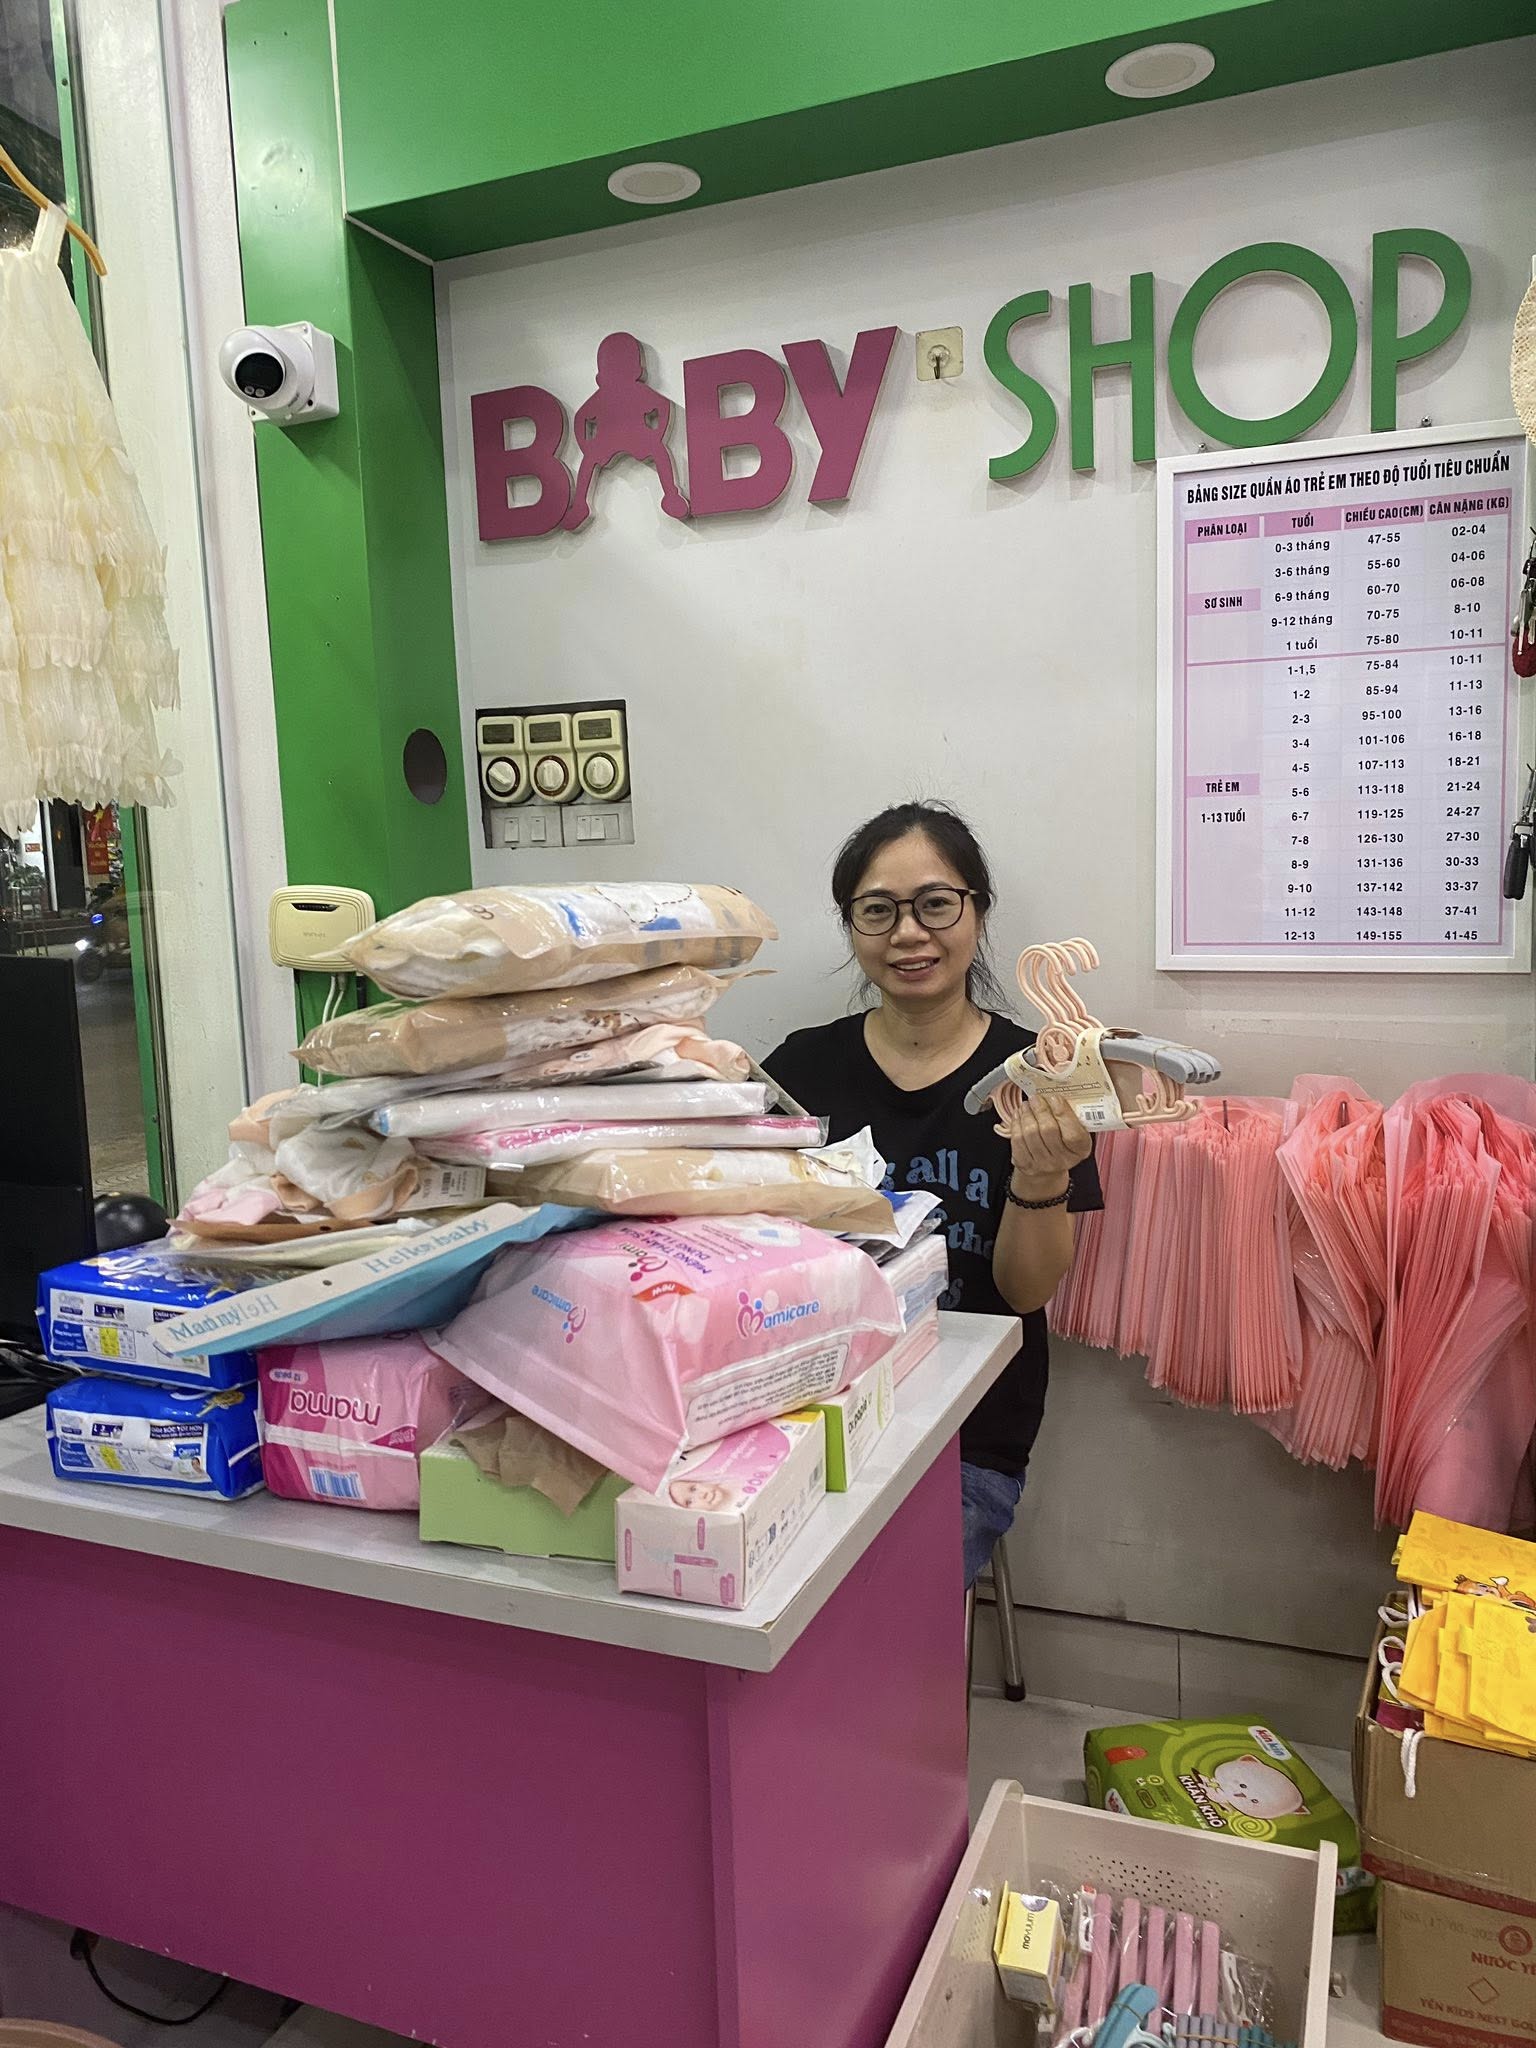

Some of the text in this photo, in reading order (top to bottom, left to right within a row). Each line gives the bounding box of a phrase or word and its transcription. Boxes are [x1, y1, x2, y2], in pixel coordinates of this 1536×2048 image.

[984, 229, 1472, 481] SHOP
[1188, 450, 1509, 503] BẢNG SIZE QUẦN ÁO TRẺ EM THEO ĐỘ TUỔI TIÊU CHUẨN
[1430, 497, 1508, 514] CÂN NẶNG (KG)
[1379, 505, 1423, 519] CAO(CM)
[1198, 523, 1246, 537] PHÂN LOẠI
[1452, 524, 1485, 536] 02-04
[1368, 533, 1400, 544] 47-55
[1276, 540, 1329, 552] 0-3 tháng
[1452, 550, 1485, 562] 04-06
[1368, 558, 1400, 569] 55-60
[1276, 565, 1329, 577] 3-6 tháng
[1451, 577, 1484, 588] 06-08
[1367, 584, 1399, 595] 60-70
[1275, 590, 1329, 602] 6-9 tháng
[1205, 596, 1242, 609] SƠ SINH
[1454, 603, 1480, 613] 8-10
[1367, 609, 1399, 620] 70-75
[1272, 616, 1332, 627] 9-12 tháng
[1451, 628, 1482, 639] 10-11
[1287, 637, 1317, 650] 1 tuổi
[1367, 634, 1399, 645] 75-80
[1451, 654, 1481, 664] 10-11
[1288, 665, 1315, 675] 1-1,5
[1367, 660, 1398, 670] 75-84
[1366, 685, 1398, 695] 85-94
[1450, 680, 1482, 690] 11-13
[1293, 690, 1310, 699] 1-2
[1362, 710, 1401, 720] 95-100
[1450, 705, 1481, 715] 13-16
[1293, 714, 1309, 724] 2-3
[1359, 734, 1404, 745] 101-106
[1449, 731, 1481, 741] 16-18
[1293, 739, 1309, 748] 3-4
[1359, 759, 1404, 770] 107-113
[1448, 756, 1479, 766] 18-21
[1292, 763, 1309, 772] 4-5
[1206, 779, 1239, 792] TRẺ EM
[1358, 784, 1403, 794] 113-118
[1447, 782, 1480, 791] 21-24
[1292, 788, 1309, 797] 5-6
[1292, 812, 1308, 821] 6-7
[1358, 809, 1403, 819] 119-125
[1447, 807, 1480, 816] 24-27
[1202, 813, 1222, 823] 1-13
[1292, 836, 1308, 845] 7-8
[1358, 834, 1403, 843] 126-130
[1447, 832, 1479, 841] 27-30
[1292, 860, 1308, 869] 8-9
[1358, 858, 1402, 867] 131-136
[1446, 857, 1478, 866] 30-33
[1288, 884, 1312, 893] 9-10
[1357, 883, 1402, 892] 137-142
[1446, 882, 1478, 891] 33-37
[1286, 908, 1315, 916] 11-12
[1357, 907, 1402, 916] 143-148
[1445, 906, 1476, 915] 37-41
[1285, 932, 1315, 940] 12-13
[1357, 931, 1402, 940] 149-155
[1445, 931, 1477, 940] 41-45
[906, 1148, 959, 1191] all
[965, 1167, 990, 1209] a
[290, 1388, 380, 1426] mama
[1199, 1804, 1228, 1828] KHÔ
